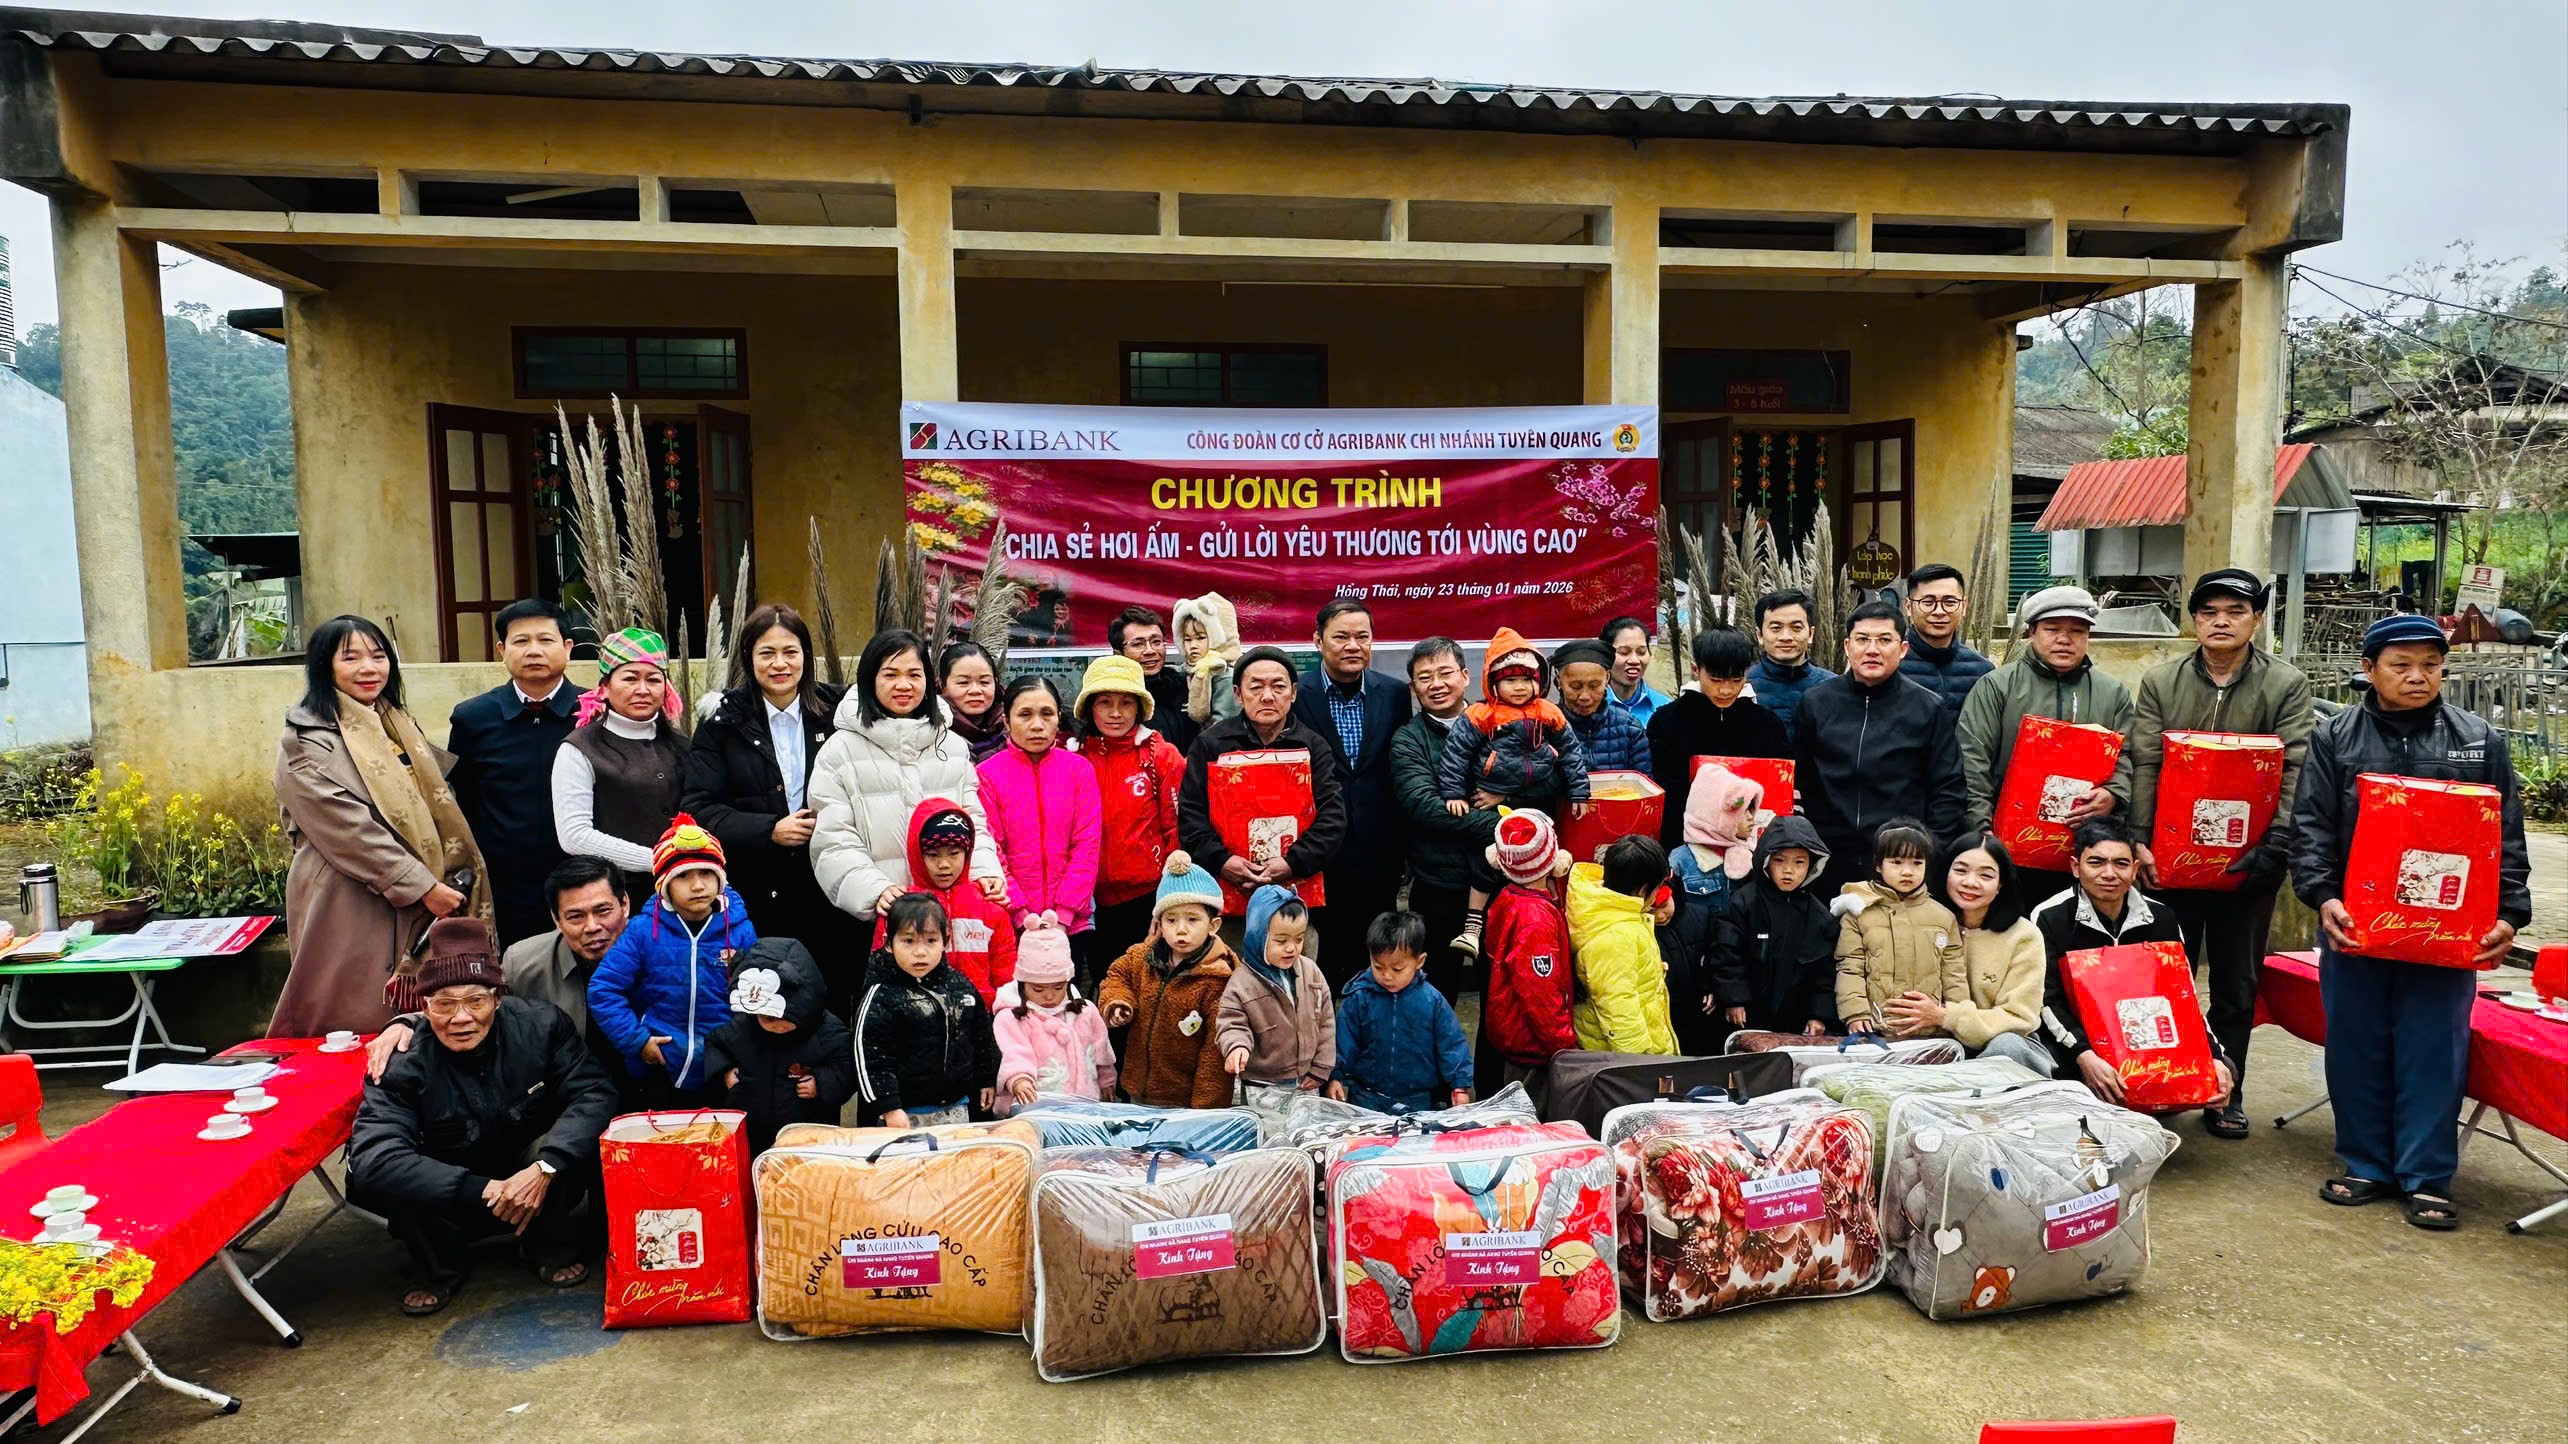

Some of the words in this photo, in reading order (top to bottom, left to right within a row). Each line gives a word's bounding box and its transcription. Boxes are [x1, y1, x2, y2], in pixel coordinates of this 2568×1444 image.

[945, 429, 1120, 450] AGRIBANK
[1187, 430, 1229, 449] CÔNG
[1232, 430, 1277, 449] ĐOÀN
[1281, 432, 1301, 449] CƠ
[1328, 433, 1407, 450] AGRIBANK
[1410, 433, 1435, 449] CHI
[1440, 429, 1495, 449] NHÁNH
[1498, 430, 1545, 449] TUYÊN
[1550, 431, 1601, 449] QUANG
[1150, 474, 1318, 509] CHƯƠNG
[1331, 469, 1441, 508] TRÌNH
[1066, 522, 1093, 559] SẺ
[1100, 530, 1137, 559] HƠI
[1145, 520, 1179, 558] ẤM
[1200, 520, 1236, 558] GỬI
[1244, 524, 1277, 557] LỜI
[1284, 525, 1326, 557] YÊU
[1333, 527, 1421, 556] THƯƠNG
[1427, 523, 1461, 556] TỚI
[1467, 523, 1527, 555] VÙNG
[1335, 582, 1368, 599] Hồng
[1372, 583, 1401, 598] Thái,
[1405, 584, 1435, 598] ngày
[1438, 584, 1453, 595] 23
[1457, 582, 1491, 598] tháng
[1495, 582, 1510, 595] 01
[1514, 583, 1540, 594] năm
[1543, 582, 1573, 594] 2026
[2370, 912, 2406, 932] Chúc
[1160, 1219, 1216, 1235] AGRIBANK
[867, 1240, 924, 1253] AGRIBANK
[1472, 1235, 1526, 1247] AGRIBANK
[805, 1252, 833, 1296] CHĂN
[928, 1230, 963, 1255] AO
[963, 1254, 989, 1287] CẤP
[622, 1281, 655, 1306] Chúc
